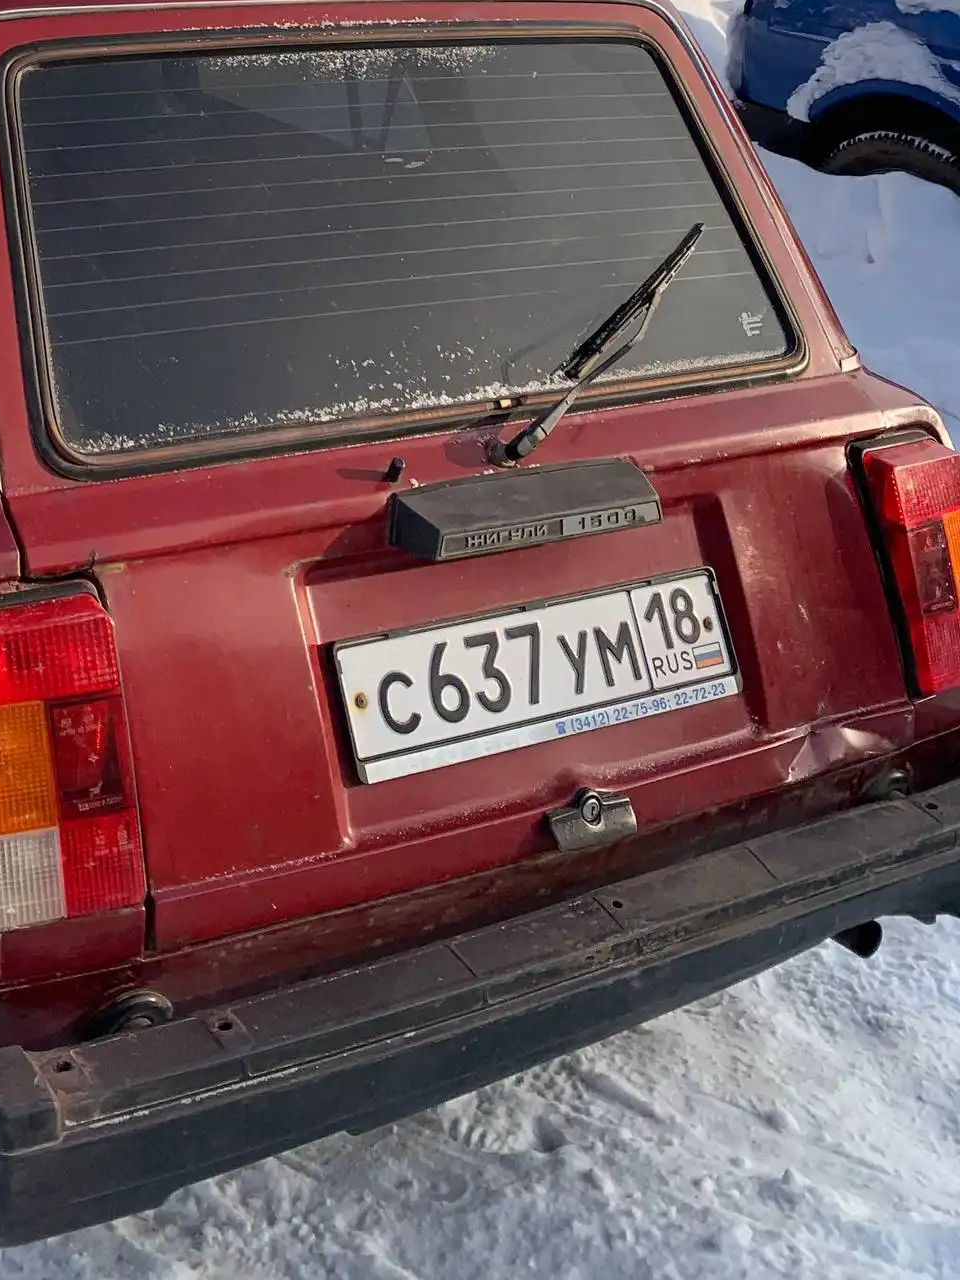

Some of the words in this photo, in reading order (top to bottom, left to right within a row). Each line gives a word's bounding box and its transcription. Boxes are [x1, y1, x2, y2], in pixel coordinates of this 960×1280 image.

[464, 523, 548, 550] ЖИГУЛИ
[578, 508, 636, 531] 1500
[643, 587, 701, 650] 18
[652, 646, 694, 679] RUS
[570, 710, 611, 733] (3412)
[674, 682, 727, 707] 22-72-23
